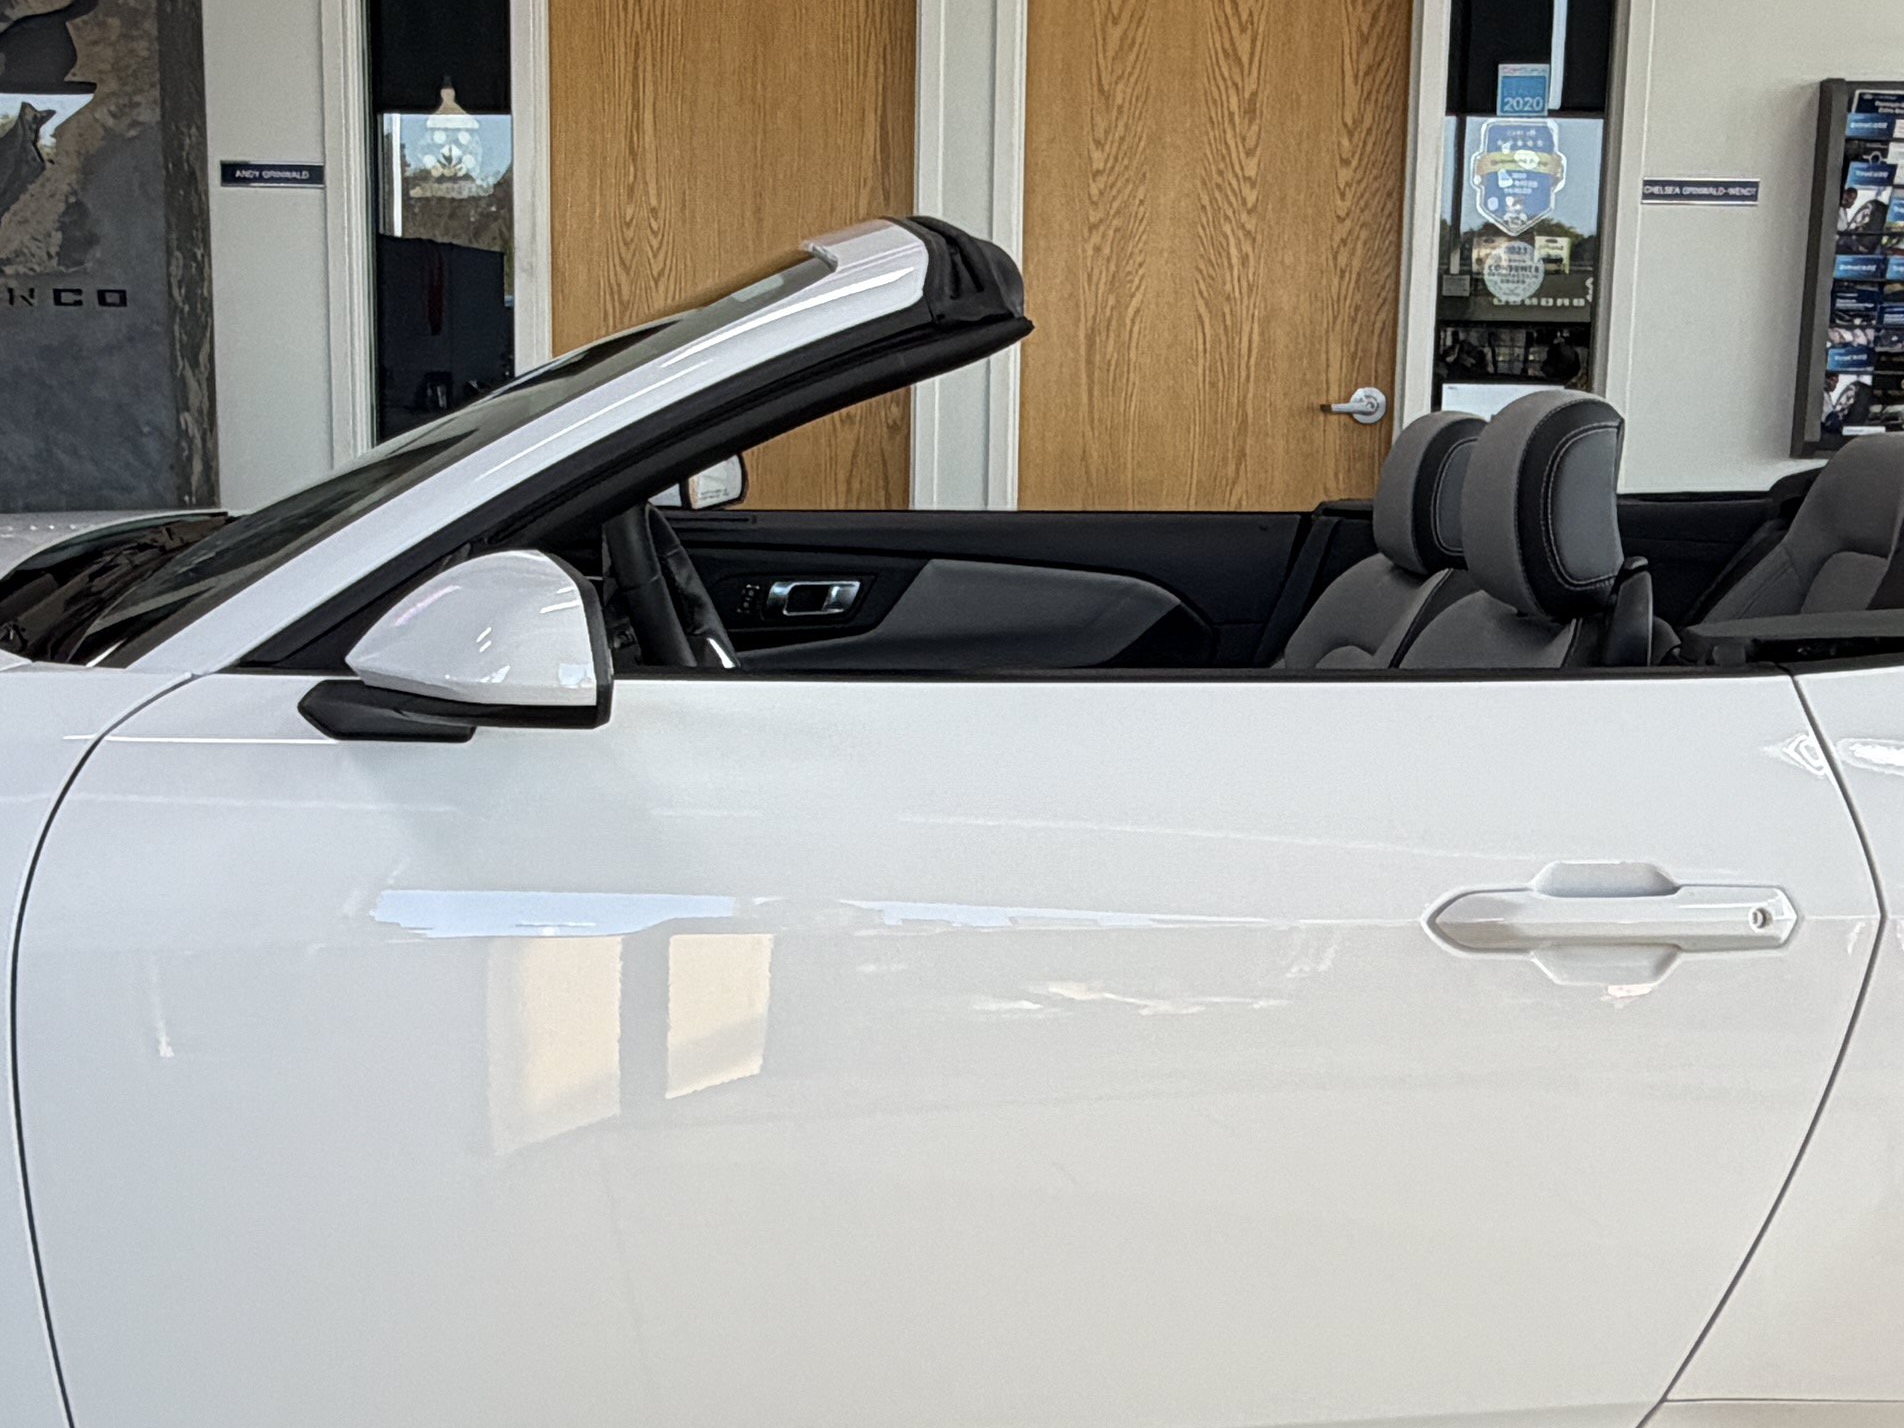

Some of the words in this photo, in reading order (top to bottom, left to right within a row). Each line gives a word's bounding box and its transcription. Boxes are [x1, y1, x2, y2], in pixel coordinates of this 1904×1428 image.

[1503, 96, 1543, 111] 2020
[234, 169, 259, 178] ANDY
[1643, 185, 1680, 195] CHELSEA
